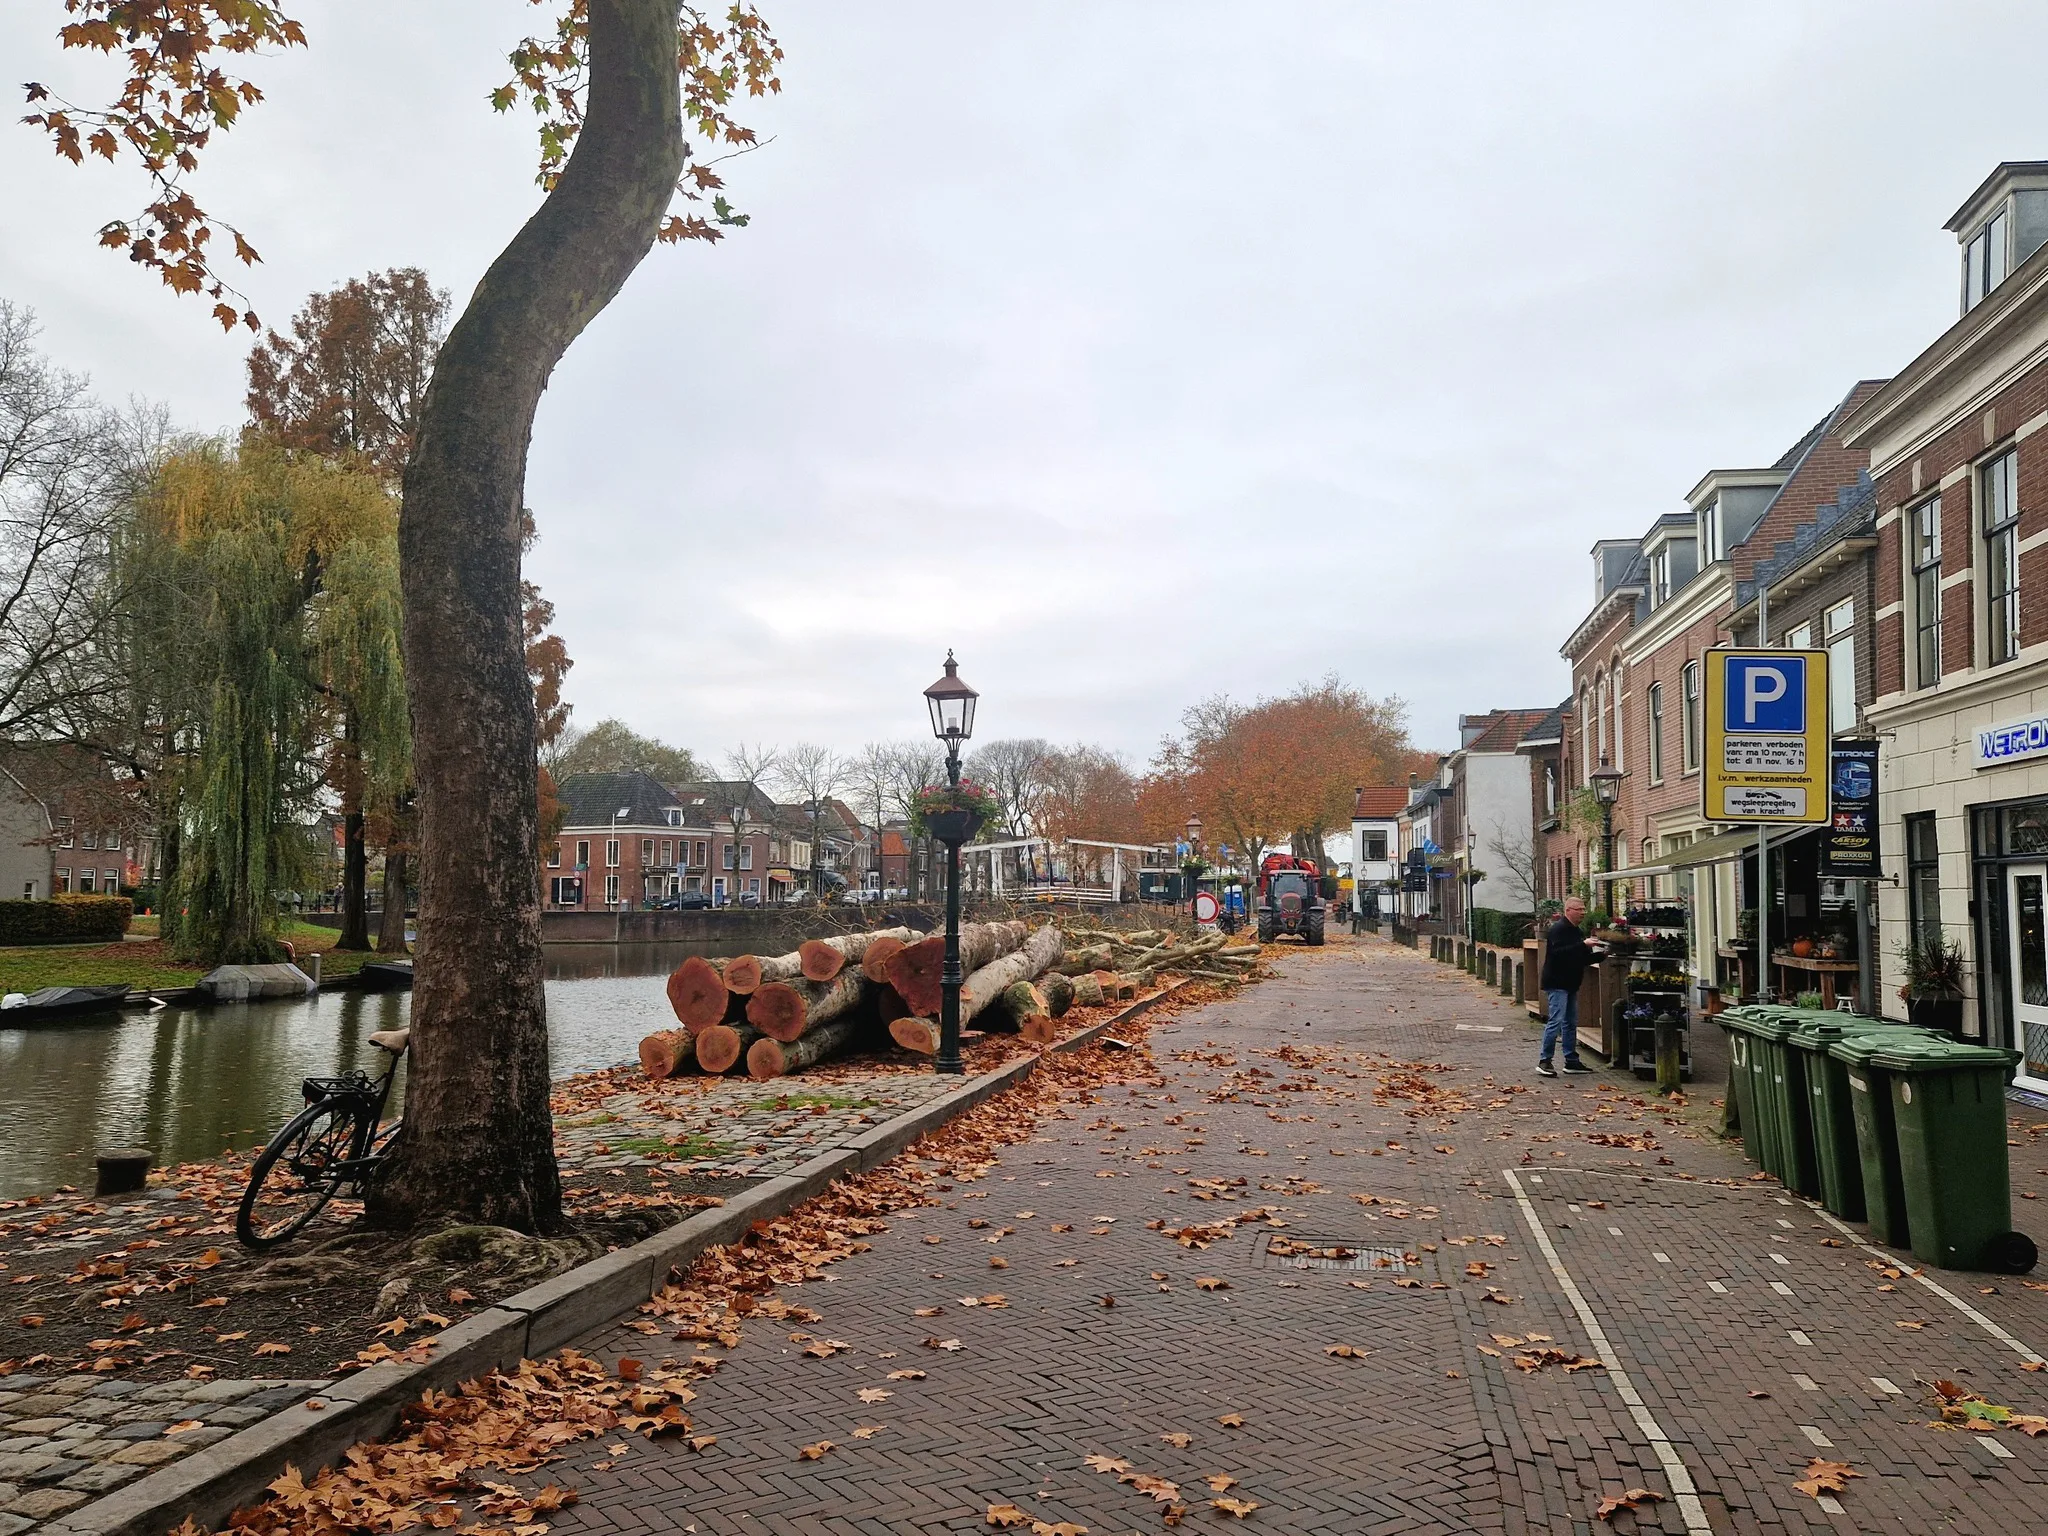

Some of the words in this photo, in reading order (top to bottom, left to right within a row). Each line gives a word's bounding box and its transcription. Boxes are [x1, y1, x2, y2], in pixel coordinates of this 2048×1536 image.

[1745, 667, 1787, 723] P
[1726, 740, 1762, 748] parkeren
[1744, 775, 1812, 783] werkzaamheden
[1731, 799, 1796, 808] wegsleepregeling
[1731, 1034, 1747, 1067] 17
